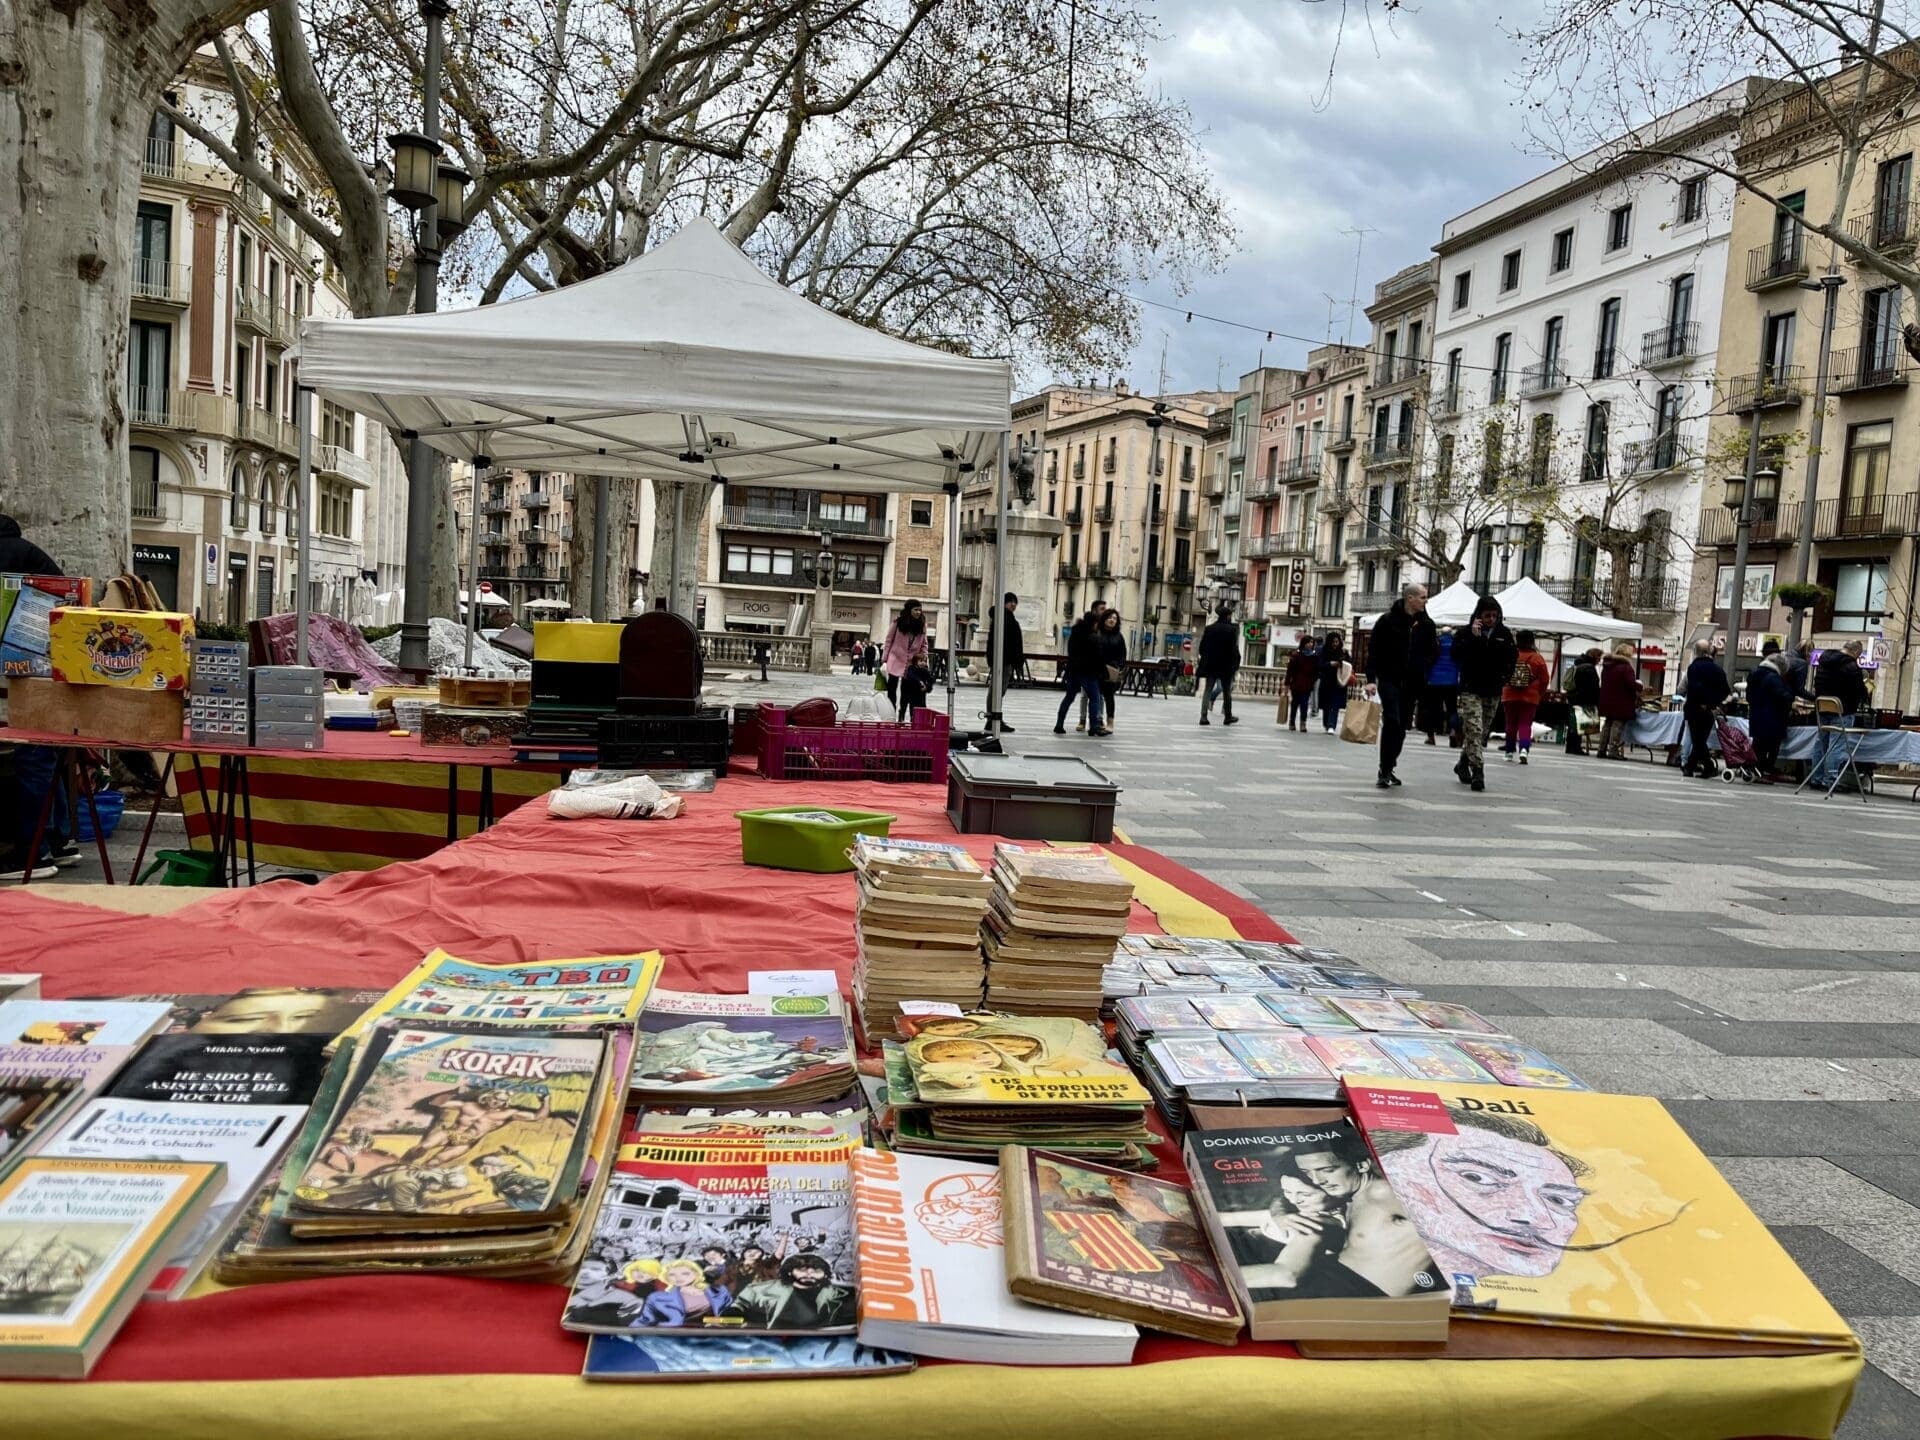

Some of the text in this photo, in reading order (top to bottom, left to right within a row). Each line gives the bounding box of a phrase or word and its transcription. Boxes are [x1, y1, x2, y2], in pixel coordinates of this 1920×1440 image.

[1290, 559, 1304, 617] HOTEL
[743, 602, 770, 613] ROIG
[516, 967, 631, 986] TBO
[441, 1049, 556, 1081] KORAK
[173, 1071, 276, 1081] HE SIDO EL
[989, 1077, 1021, 1085] LOS
[144, 1081, 289, 1092] ASISTENTE DEL
[1003, 1083, 1129, 1091] PASTORCILLOS
[169, 1093, 252, 1102] DOCTOR
[1387, 1099, 1440, 1110] historias
[1456, 1096, 1536, 1116] Dalí
[104, 1111, 268, 1128] Adolescentes
[83, 1136, 109, 1146] Eva
[113, 1136, 147, 1146] Bach
[1202, 1130, 1342, 1149] DOMINIQUE BONA
[1214, 1157, 1264, 1172] Gala
[697, 1176, 792, 1191] PRIMAVERA
[797, 1177, 822, 1191] DEL
[1046, 1260, 1083, 1276] LA
[1067, 1274, 1231, 1316] CATALANA
